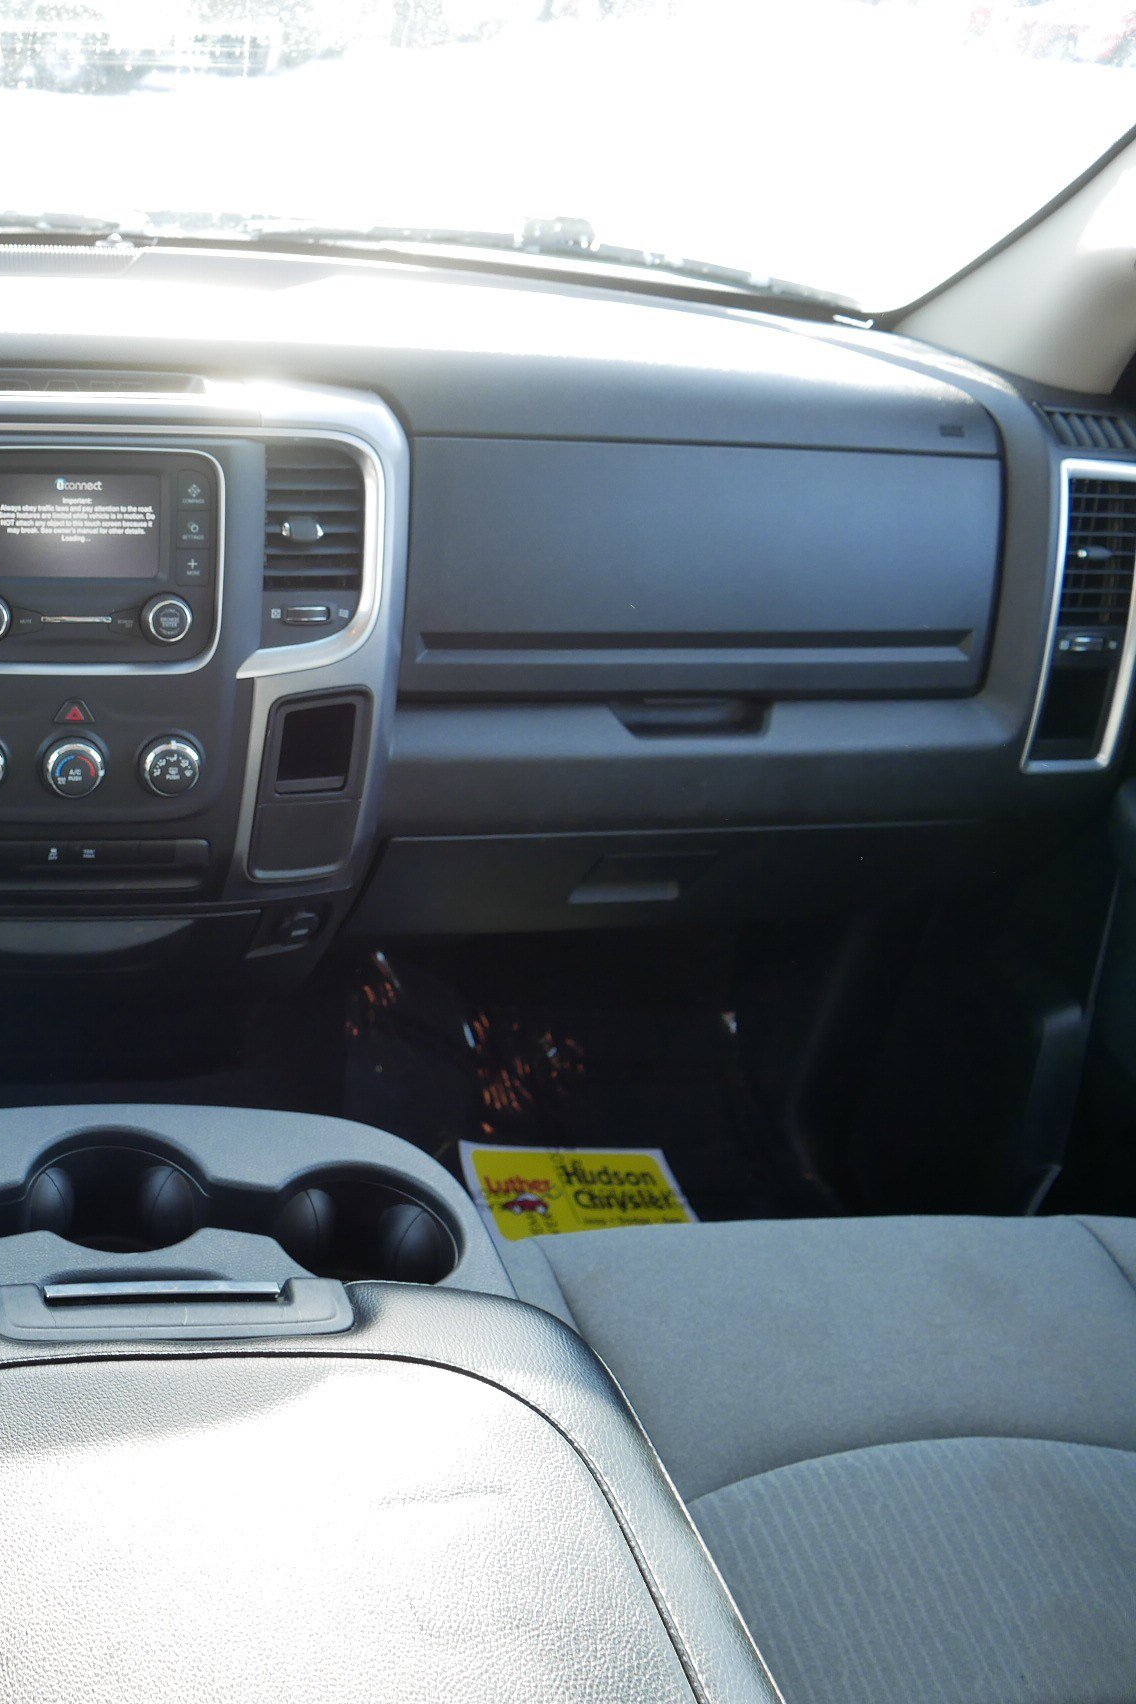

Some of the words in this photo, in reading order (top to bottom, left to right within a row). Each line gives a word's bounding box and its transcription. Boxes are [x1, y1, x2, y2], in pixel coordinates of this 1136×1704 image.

[0, 504, 22, 512] Always
[69, 504, 82, 512] and
[82, 504, 94, 512] pay
[94, 504, 120, 512] attention
[120, 504, 127, 512] to
[127, 504, 138, 512] the
[62, 497, 93, 505] Important:
[559, 1159, 658, 1186] Hudson
[484, 1174, 550, 1194] Luther
[574, 1186, 672, 1213] Chrysler
